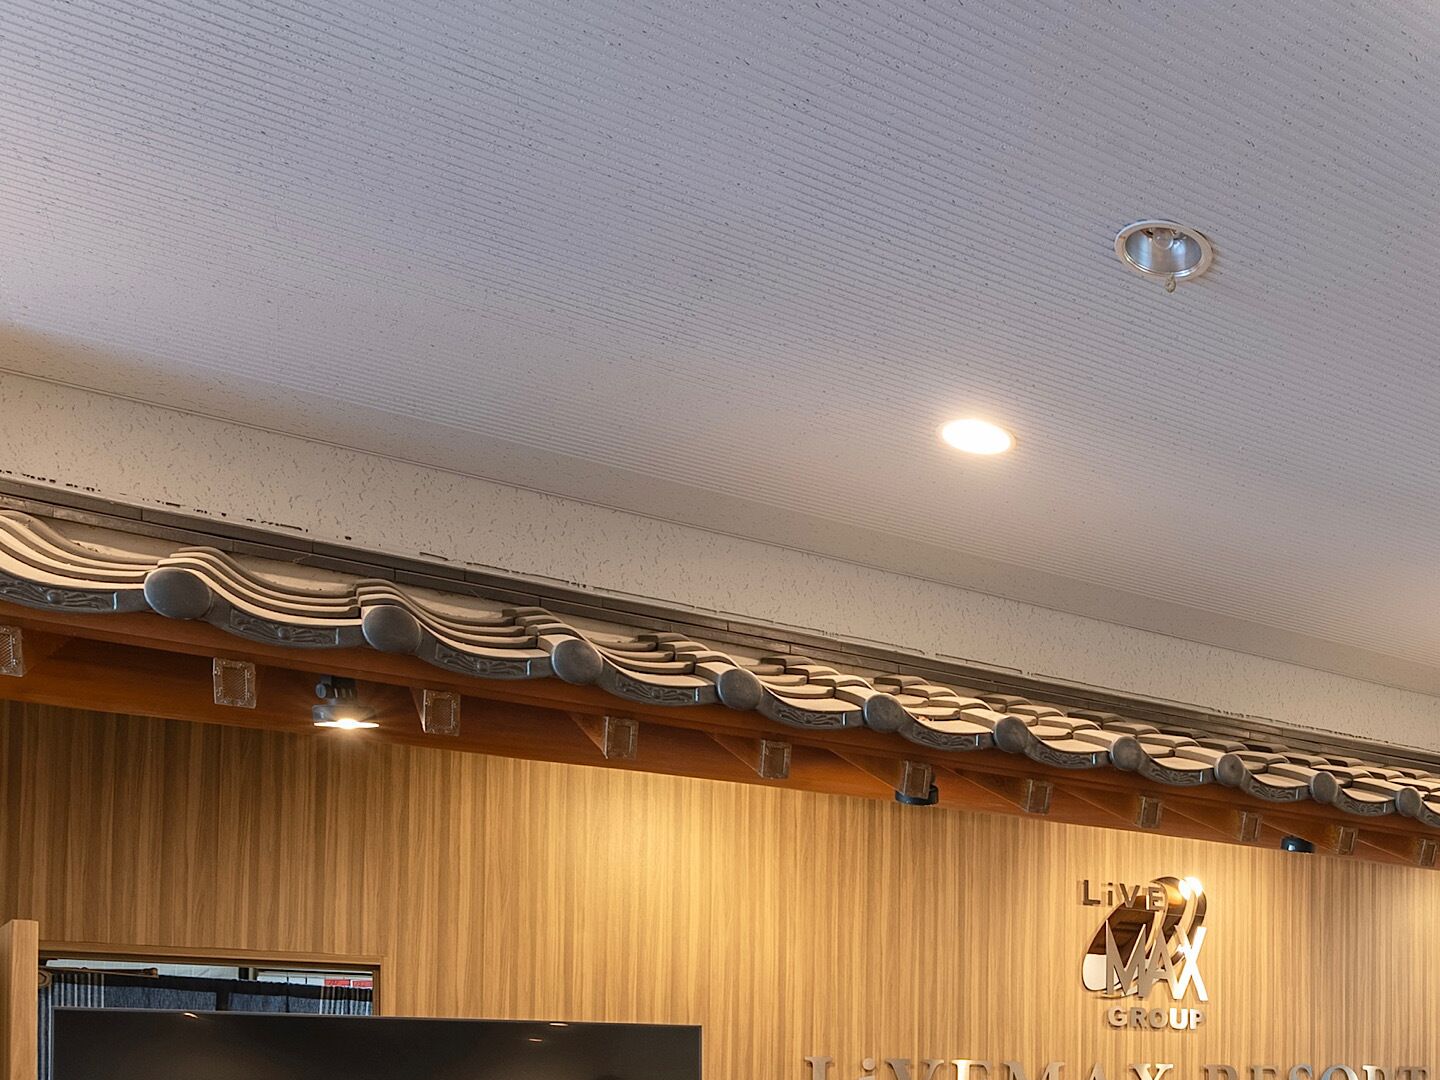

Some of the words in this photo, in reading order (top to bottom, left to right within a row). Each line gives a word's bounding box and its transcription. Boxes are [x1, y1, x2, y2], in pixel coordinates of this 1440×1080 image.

[1081, 879, 1165, 912] LiVE
[1104, 921, 1209, 1001] MAX
[1107, 1006, 1206, 1030] GROUP
